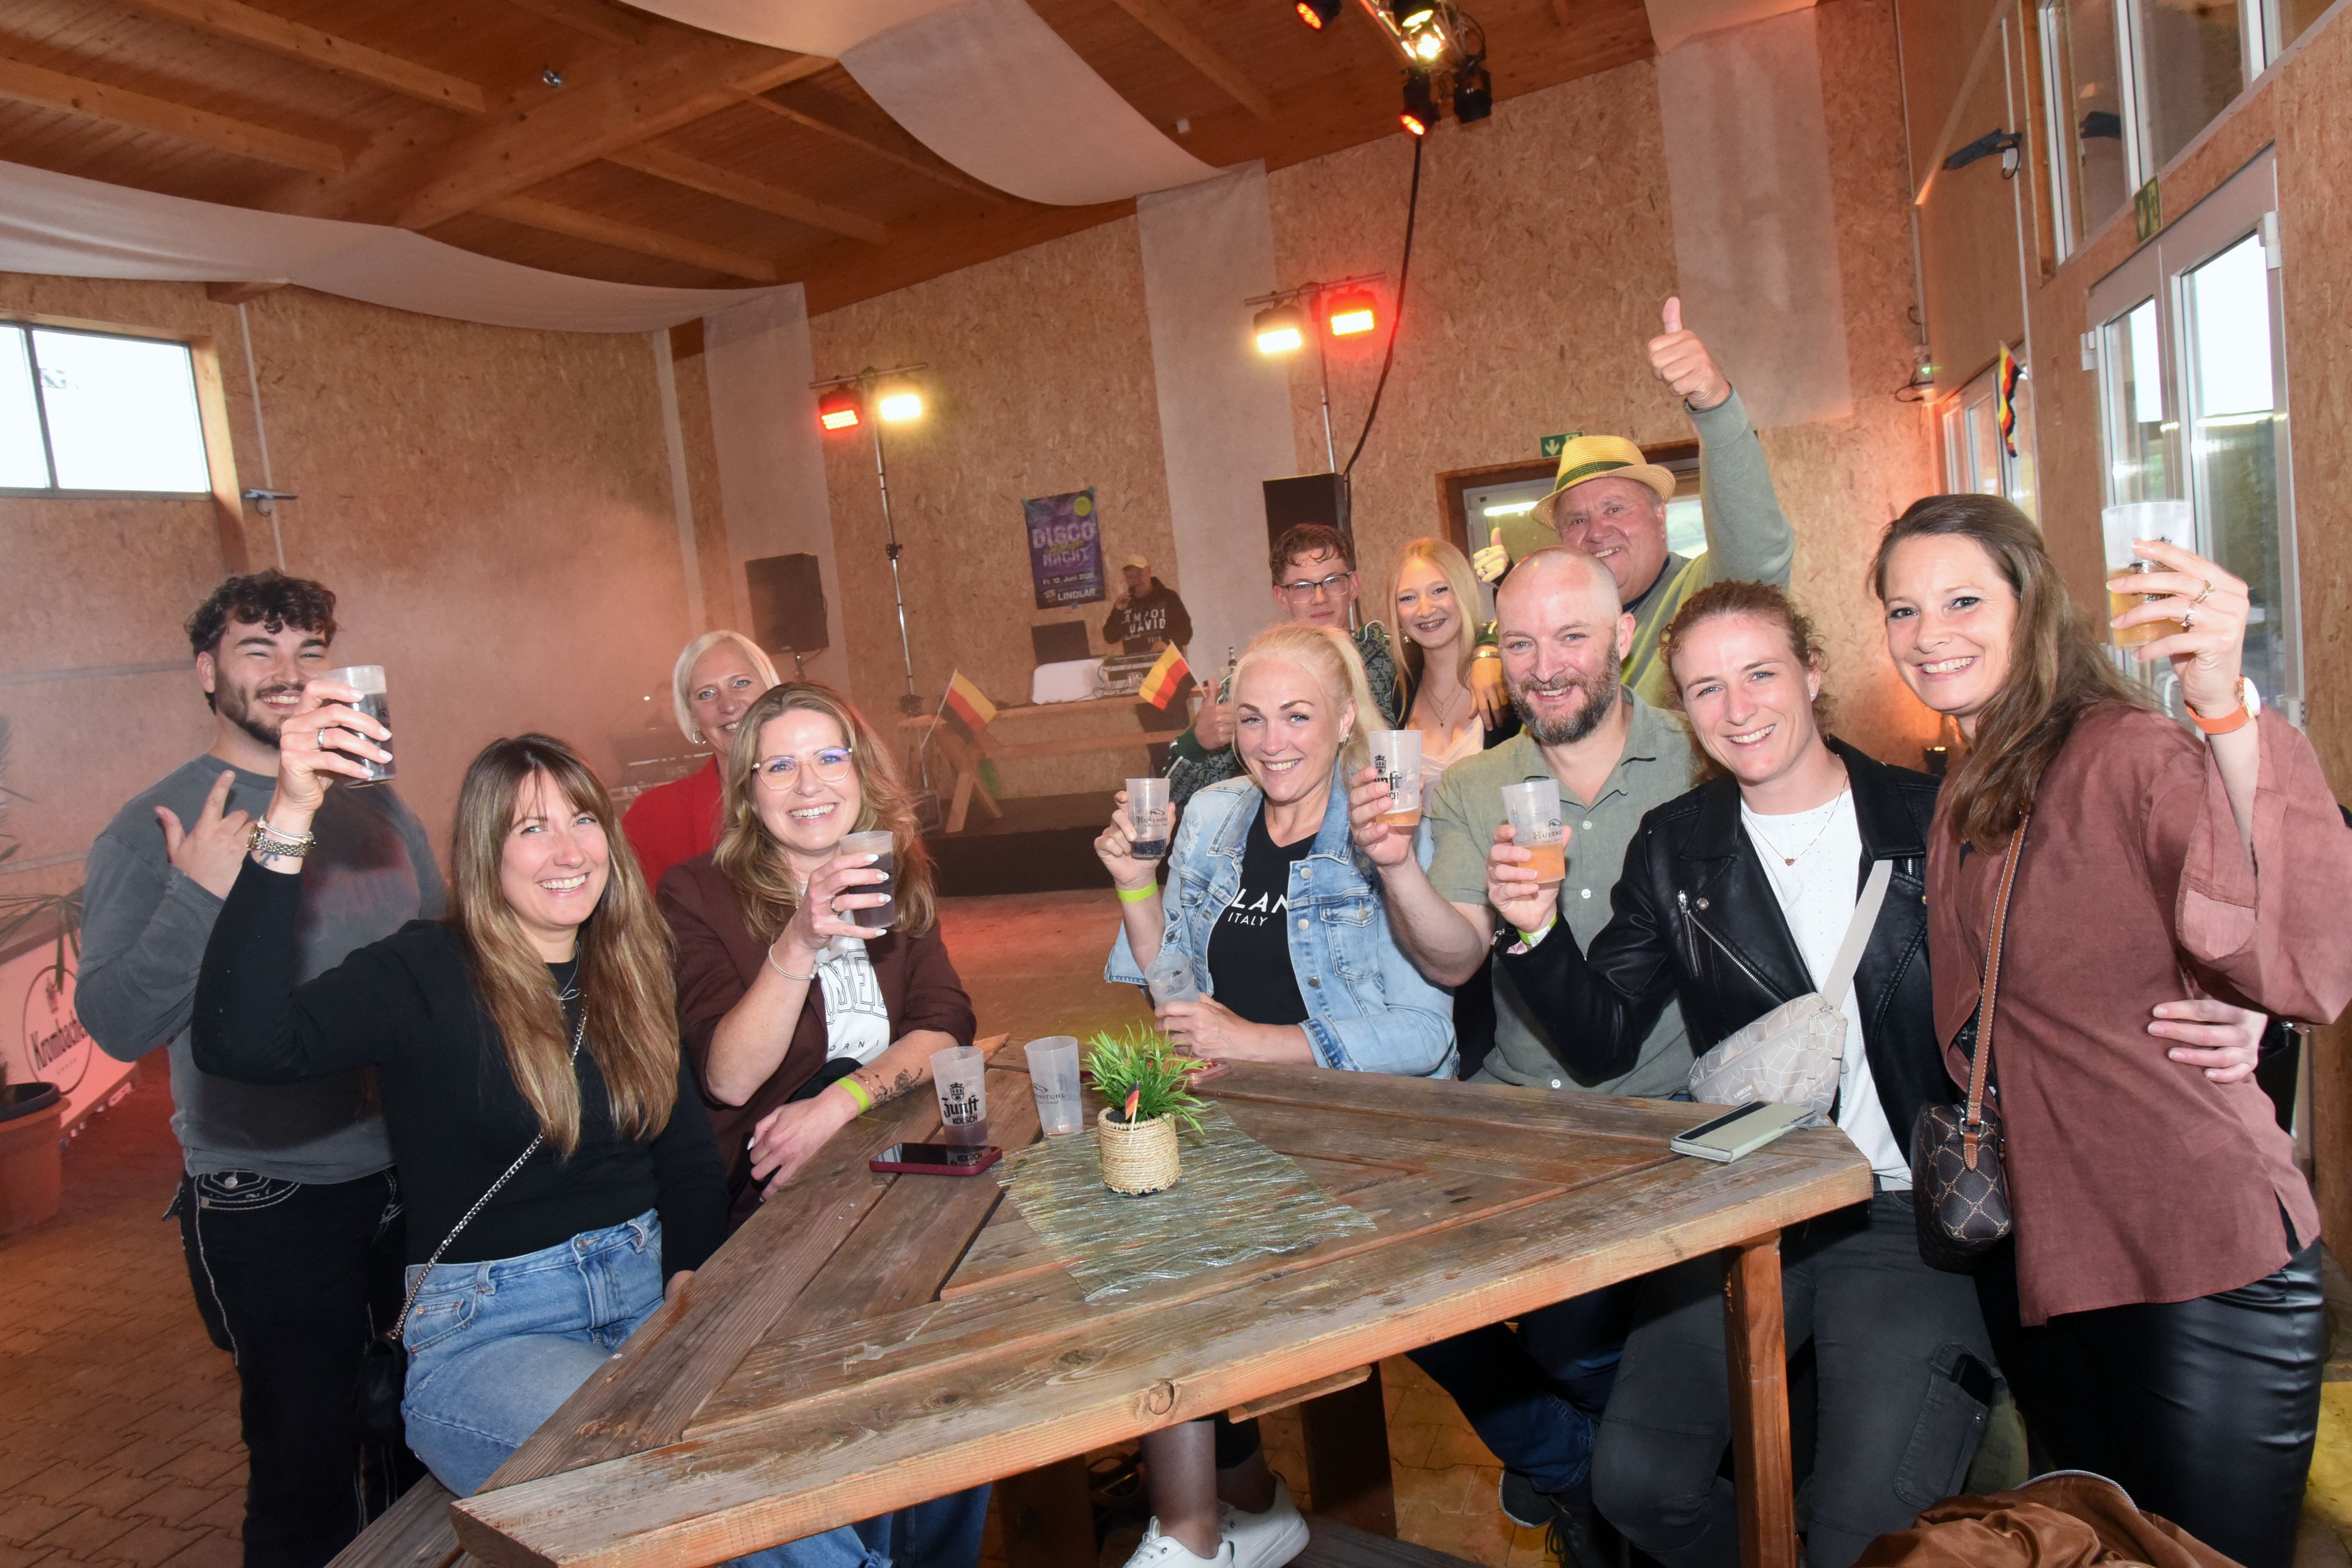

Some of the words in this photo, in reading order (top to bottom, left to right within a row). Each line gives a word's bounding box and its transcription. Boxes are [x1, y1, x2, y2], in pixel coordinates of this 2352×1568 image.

[1032, 521, 1095, 549] DISCO
[1043, 547, 1089, 567] NACHT
[1057, 588, 1095, 600] LINDLAR
[1228, 912, 1268, 926] ITALY
[941, 1094, 979, 1118] Zunft
